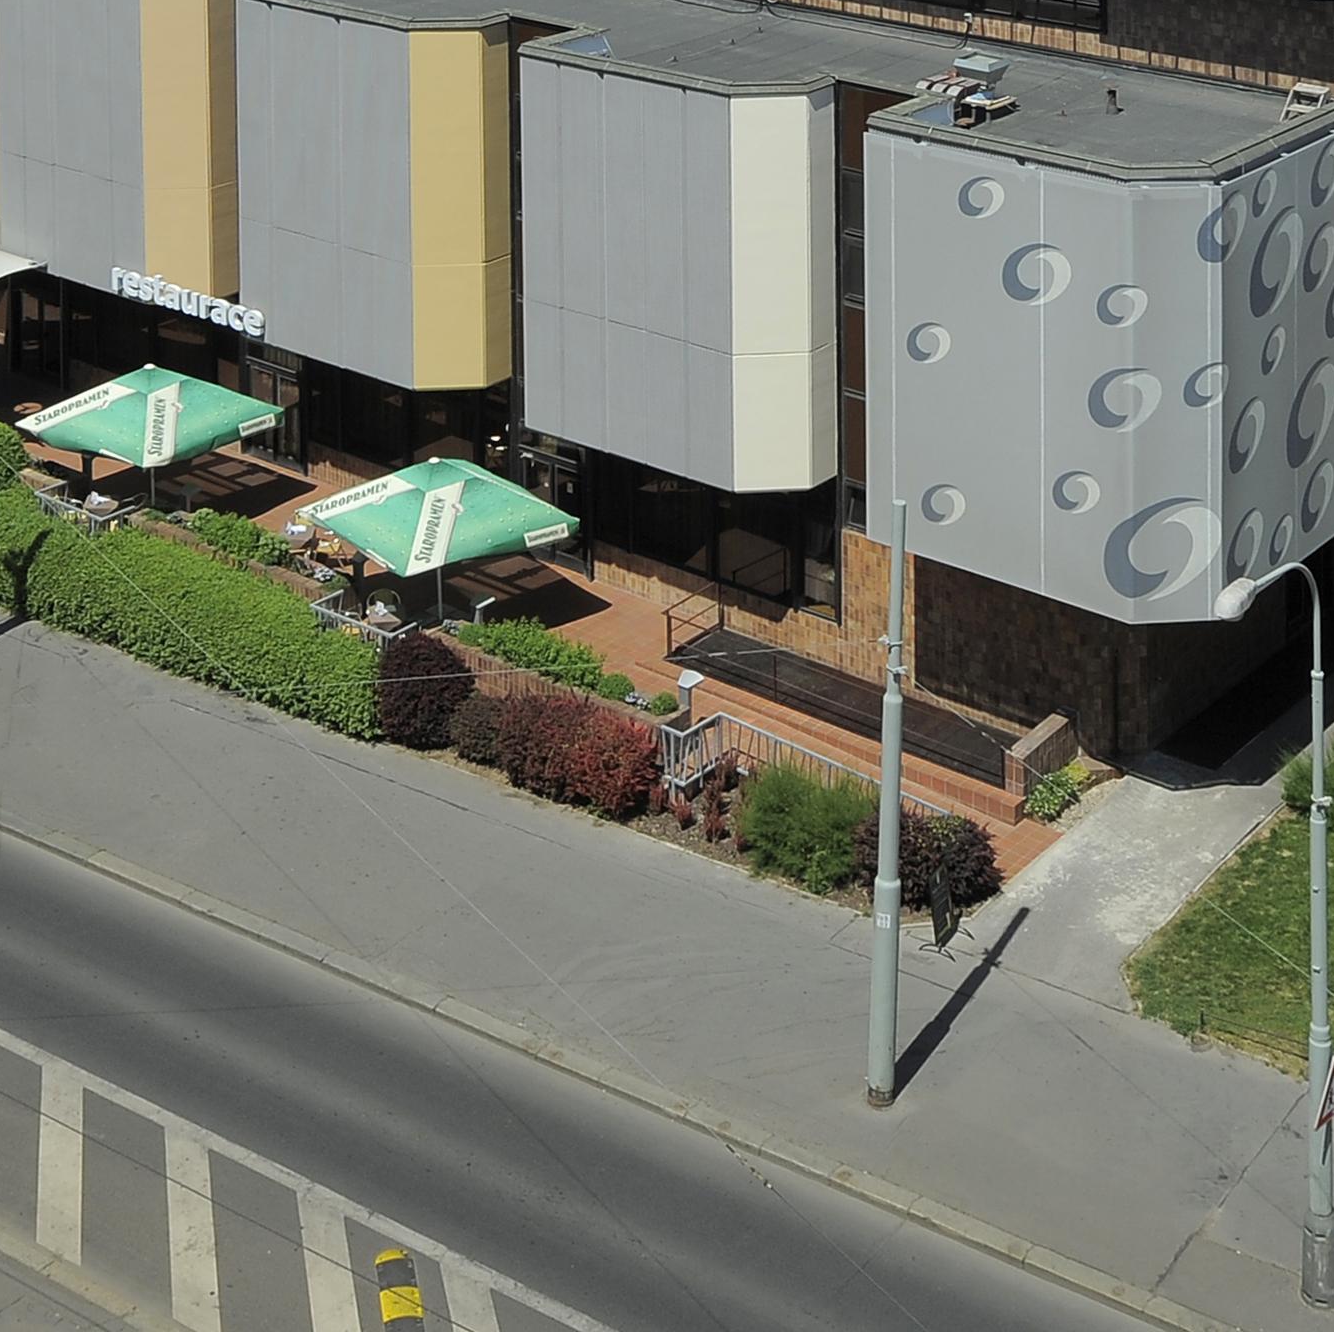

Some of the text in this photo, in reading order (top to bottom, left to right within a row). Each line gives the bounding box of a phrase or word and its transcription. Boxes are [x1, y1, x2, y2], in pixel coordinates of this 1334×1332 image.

[111, 266, 266, 336] restaurace
[34, 388, 111, 426] STAROPRAMEN
[147, 397, 166, 457] STAROPRAMEN
[311, 481, 389, 516] STAROPRAMEN
[414, 495, 447, 564] STAROPRAMEN
